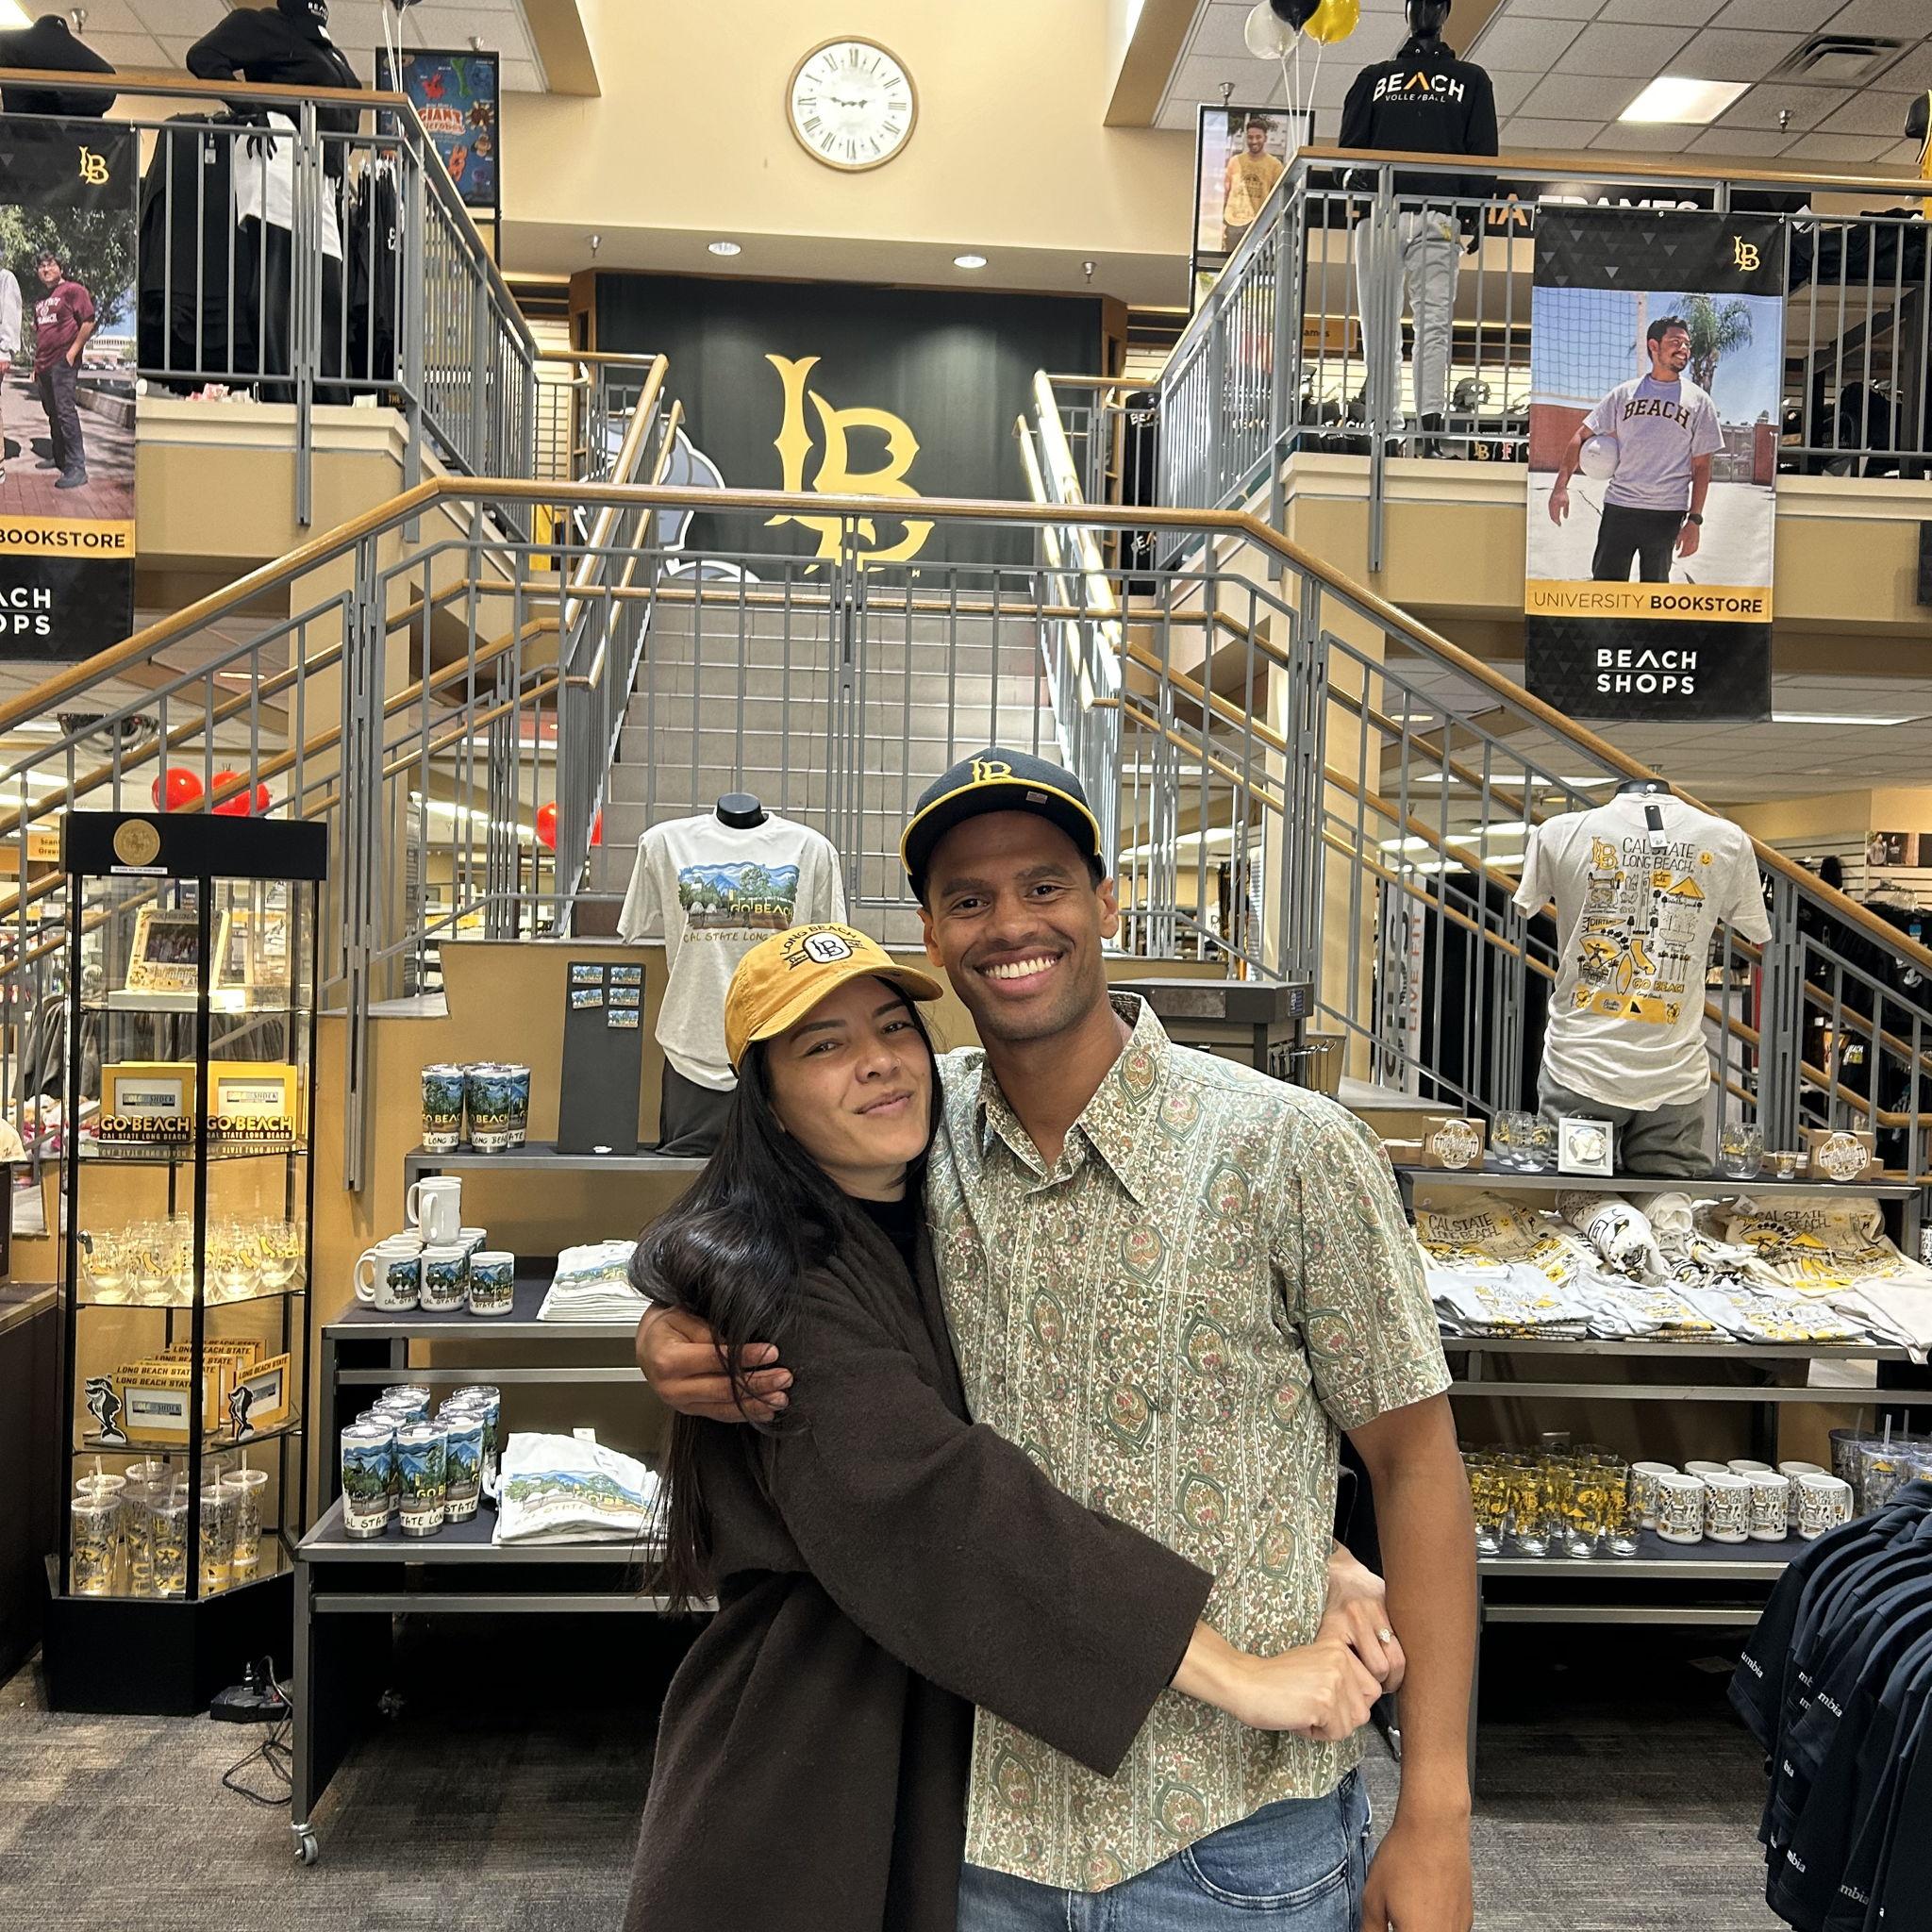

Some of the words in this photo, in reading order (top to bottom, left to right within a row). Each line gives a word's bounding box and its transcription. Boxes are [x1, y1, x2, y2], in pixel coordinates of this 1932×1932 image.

[1373, 71, 1465, 103] BEACH
[78, 146, 109, 185] LB
[1733, 236, 1761, 272] LB
[1623, 399, 1690, 429] BEACH
[764, 354, 936, 575] LB
[1534, 591, 1644, 609] UNIVERSITY
[1650, 595, 1763, 613] BOOKSTORE
[1596, 648, 1697, 670] BEACH
[1596, 674, 1695, 695] SHOPS
[1591, 836, 1618, 870] LB
[1623, 837, 1650, 855] CAL
[1622, 854, 1651, 869] LONG
[684, 932, 701, 943] CAL
[705, 931, 739, 941] STATE
[742, 931, 768, 942] LONG
[779, 930, 808, 956] LONG
[808, 924, 858, 939] BEACH
[808, 939, 845, 958] LB
[100, 1115, 128, 1132] GO
[132, 1116, 190, 1132] BEACH
[207, 1115, 232, 1131] GO
[235, 1116, 293, 1131] BEACH
[245, 1131, 264, 1140] LONG
[266, 1131, 291, 1140] BEACH
[427, 1137, 447, 1145] LONG
[1429, 1214, 1454, 1230] CAL
[1452, 1212, 1494, 1228] STATE
[1461, 1225, 1502, 1241] BEACH
[225, 1346, 252, 1356] STATE
[207, 1357, 234, 1365] STATE
[116, 1366, 140, 1374] LONG
[141, 1367, 169, 1375] BEACH
[115, 1376, 139, 1385] LONG
[139, 1377, 167, 1387] BEACH
[416, 1489, 437, 1498] GO
[444, 1500, 475, 1513] STATE
[1740, 1651, 1764, 1679] umbia
[1817, 1691, 1844, 1718] mbia
[1839, 1884, 1870, 1906] mbia
